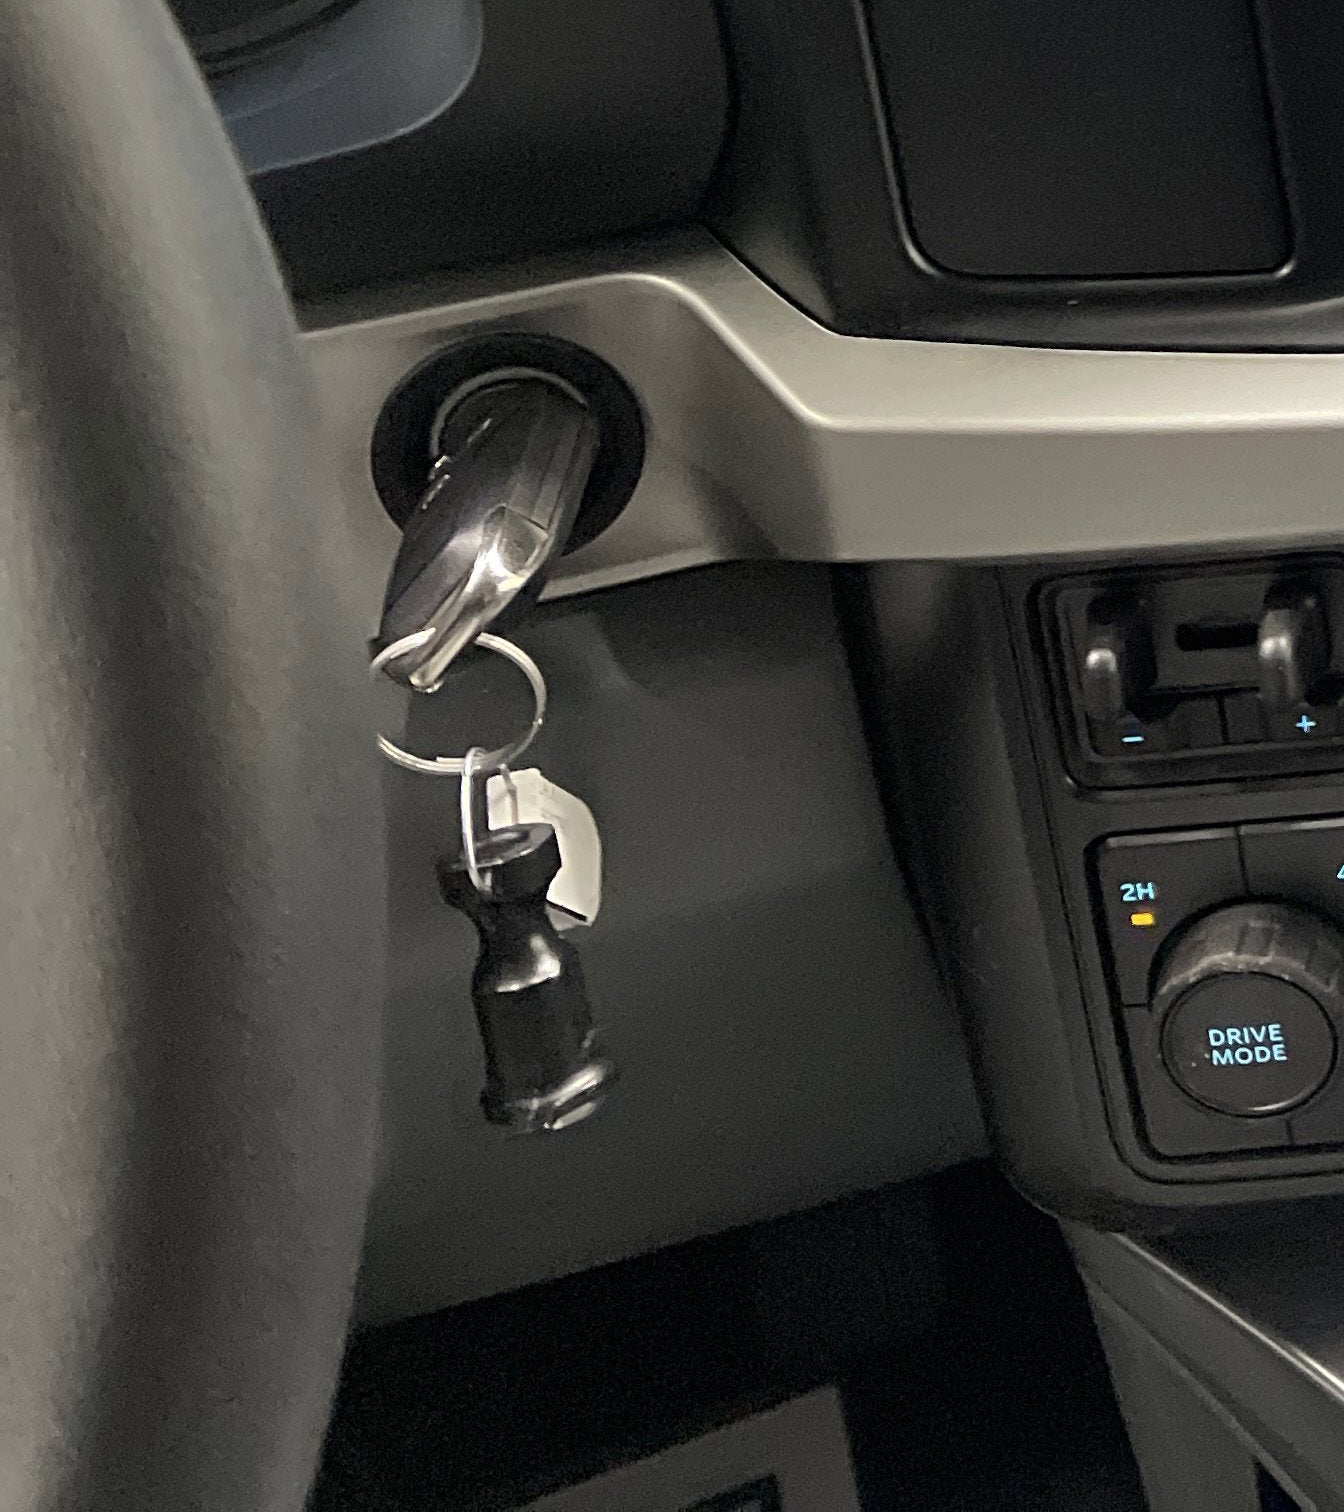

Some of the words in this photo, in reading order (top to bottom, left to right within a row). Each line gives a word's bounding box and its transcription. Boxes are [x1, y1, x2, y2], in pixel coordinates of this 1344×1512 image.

[1119, 883, 1155, 902] 2H
[1208, 1023, 1282, 1047] DRIVE
[1211, 1043, 1288, 1066] MODE
